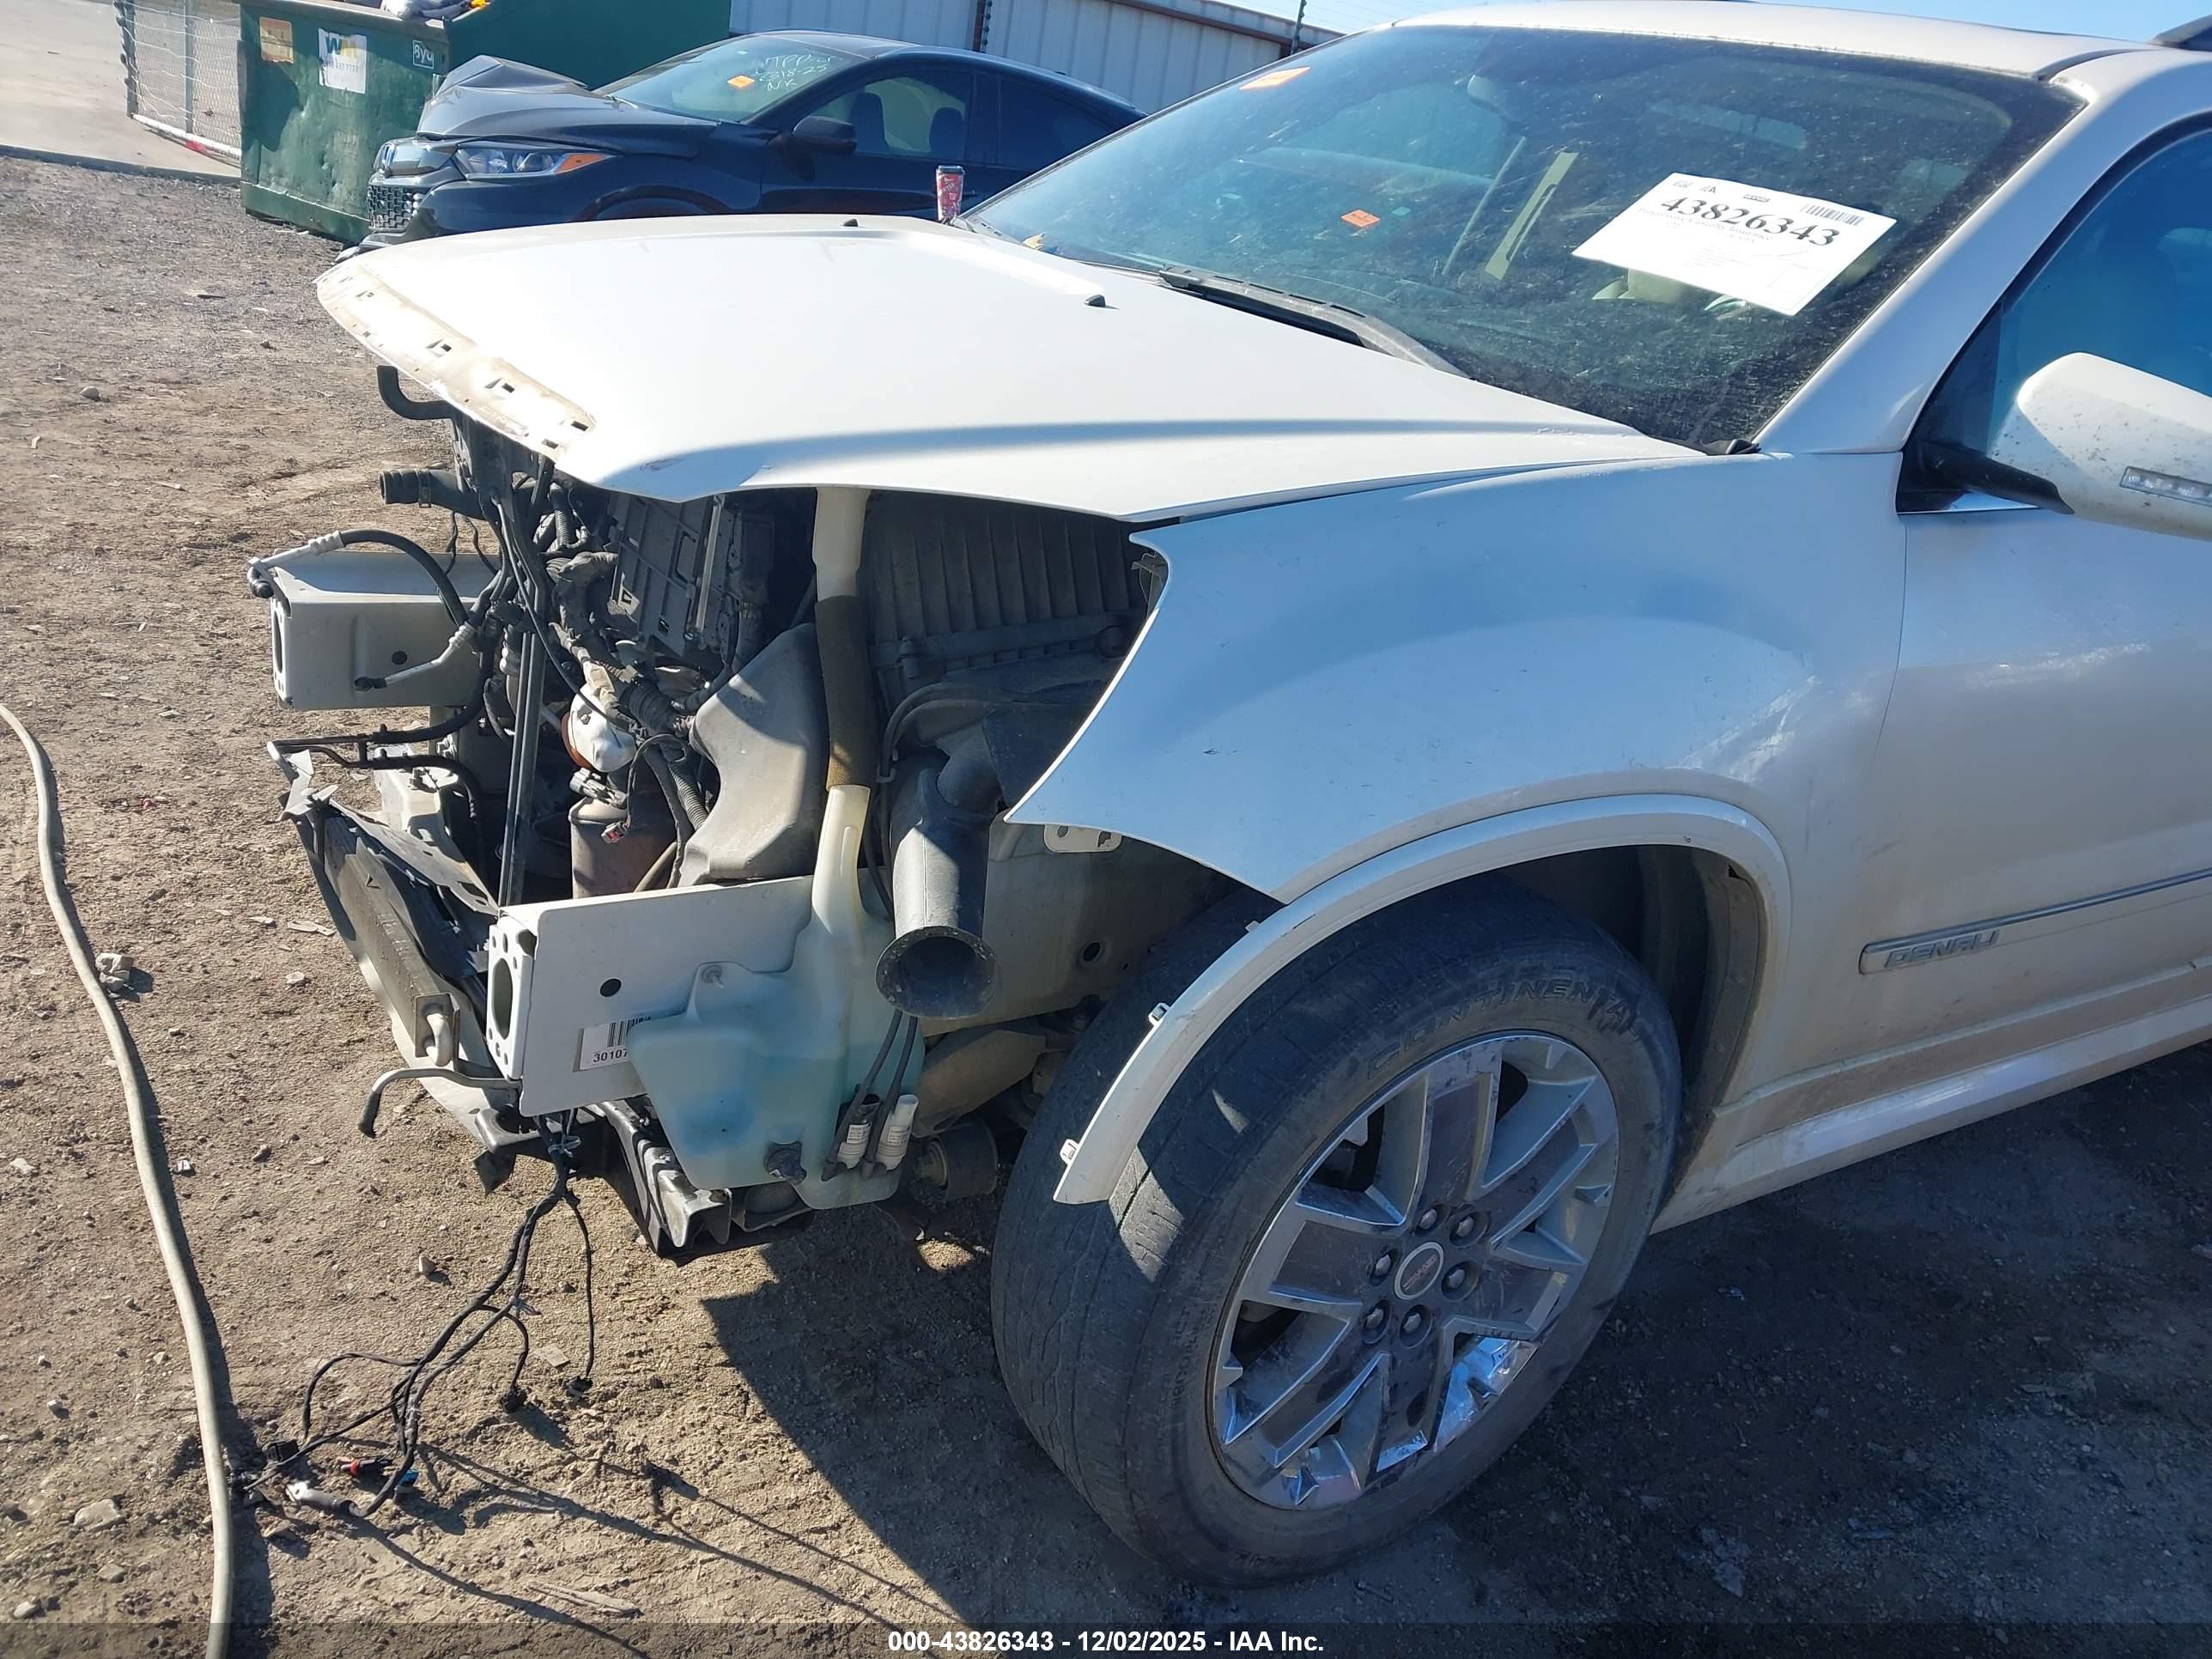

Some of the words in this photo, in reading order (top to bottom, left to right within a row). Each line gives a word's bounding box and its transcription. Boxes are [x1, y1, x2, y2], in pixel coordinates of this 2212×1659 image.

[1661, 197, 1840, 246] 43826343
[1884, 929, 2000, 968] DENALI
[592, 1048, 628, 1063] 30107
